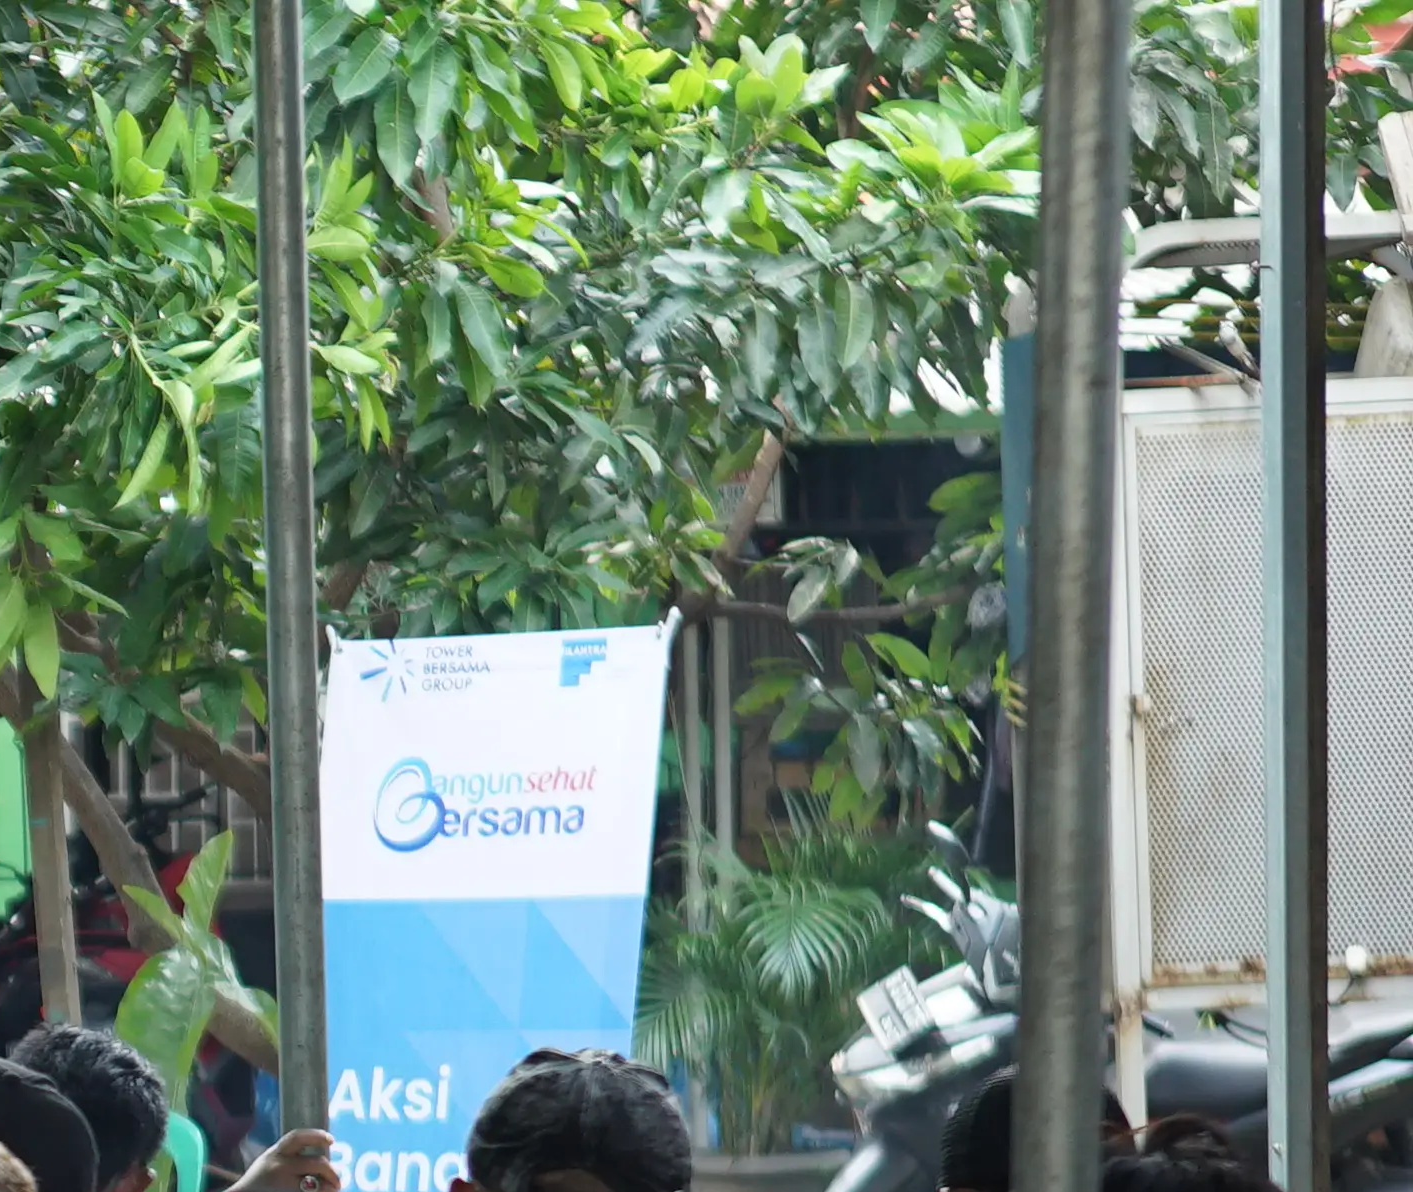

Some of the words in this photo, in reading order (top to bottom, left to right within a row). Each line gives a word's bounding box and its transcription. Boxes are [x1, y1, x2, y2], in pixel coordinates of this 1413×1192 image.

[425, 645, 473, 659] TOWER
[423, 661, 491, 676] BERSAMA
[422, 678, 473, 692] GROUP
[328, 1063, 452, 1121] Aksi
